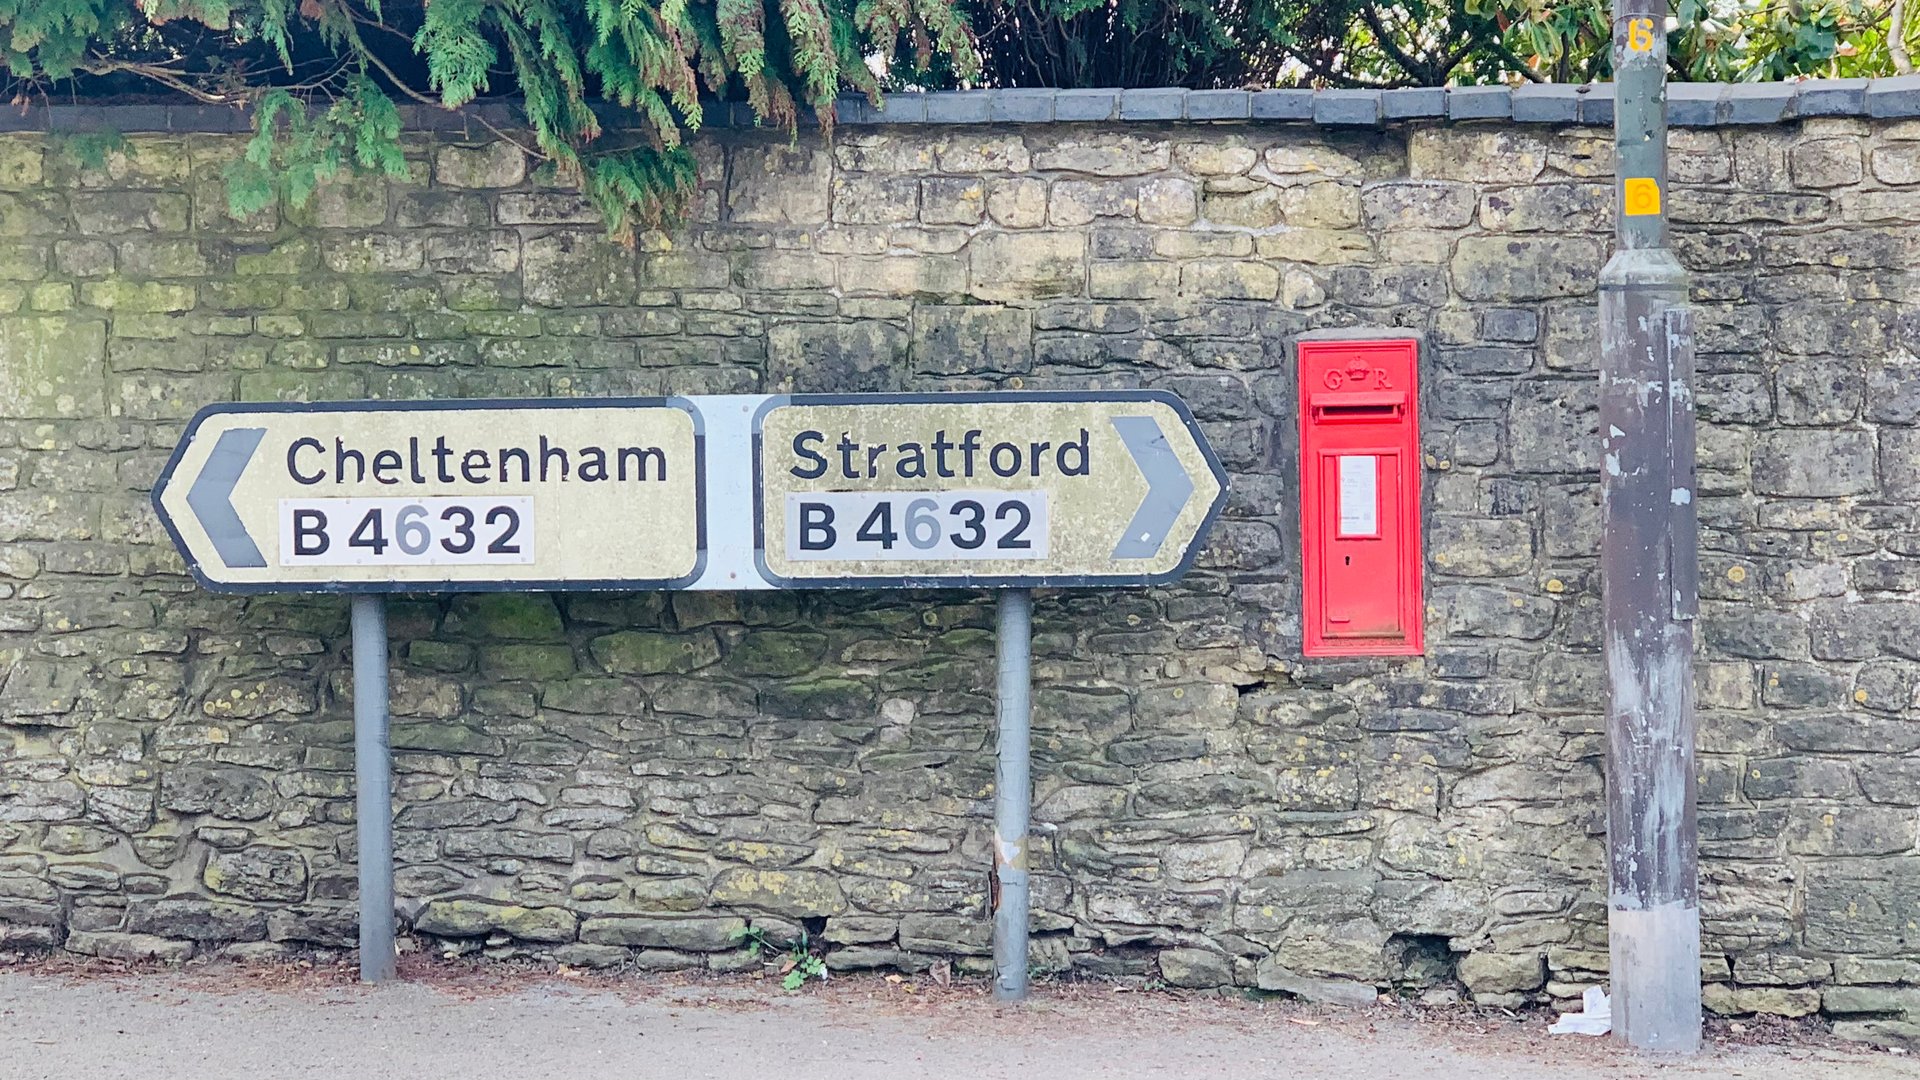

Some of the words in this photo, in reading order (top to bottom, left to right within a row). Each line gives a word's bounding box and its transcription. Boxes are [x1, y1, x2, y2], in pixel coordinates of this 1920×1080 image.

[1628, 18, 1654, 52] 6
[1633, 183, 1653, 209] 6
[1372, 366, 1393, 390] R
[286, 434, 667, 485] Cheltenham
[789, 427, 1090, 480] Stratford
[293, 507, 330, 556] B
[348, 504, 521, 555] 4632
[799, 502, 837, 551] B
[856, 497, 1032, 550] 4632
